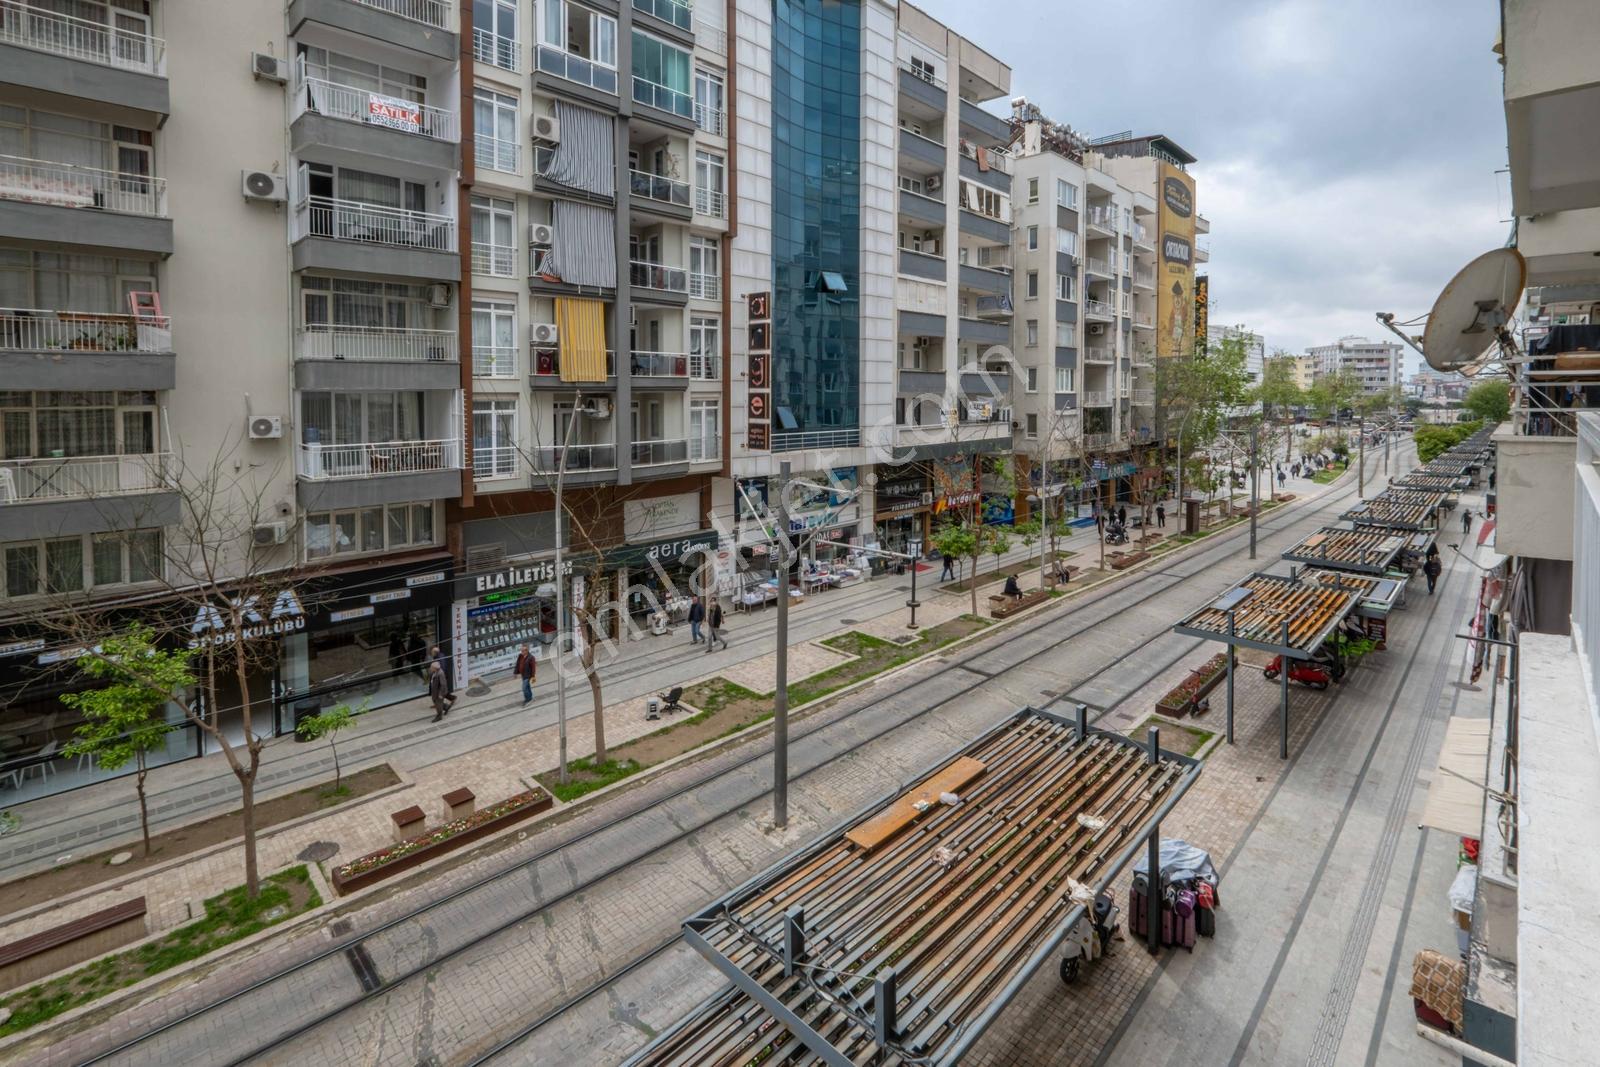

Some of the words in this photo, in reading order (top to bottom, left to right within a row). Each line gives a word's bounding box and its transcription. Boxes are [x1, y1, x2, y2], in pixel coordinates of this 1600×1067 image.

[372, 104, 417, 123] SATILIK
[649, 539, 691, 560] aera
[476, 573, 505, 592] ELA
[191, 590, 305, 634] AKA
[242, 615, 305, 640] KULÜBÜ
